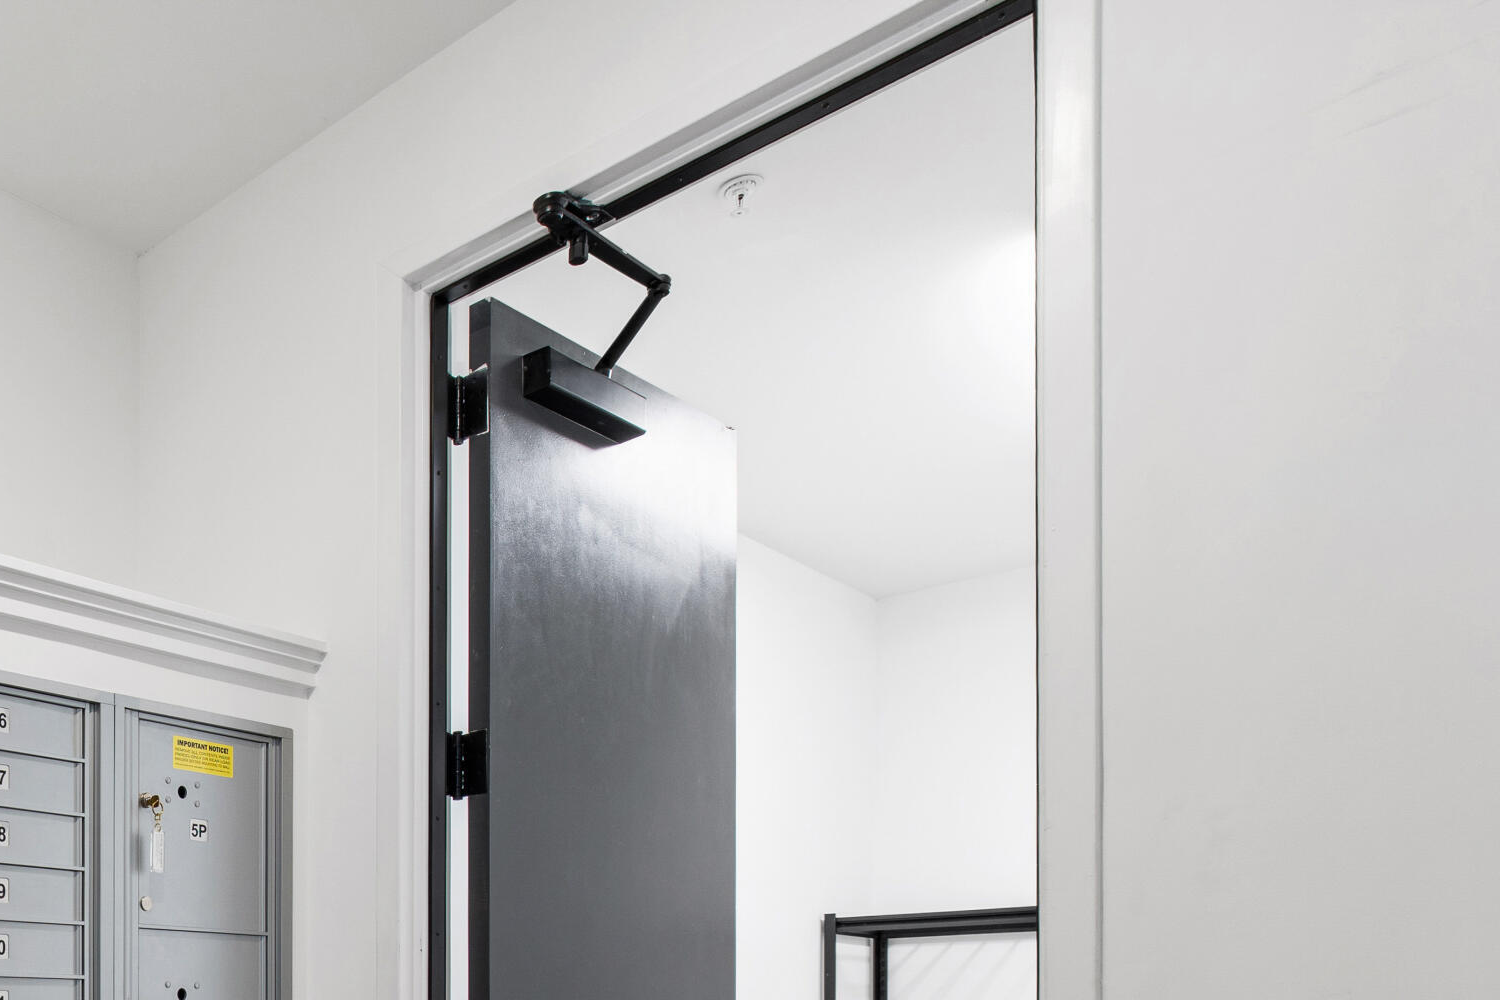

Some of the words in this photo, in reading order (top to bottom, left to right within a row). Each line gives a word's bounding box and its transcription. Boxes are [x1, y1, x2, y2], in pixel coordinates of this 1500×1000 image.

[177, 739, 208, 750] IMPORTANT
[208, 745, 229, 755] NOTICE!
[191, 823, 207, 838] 5P
